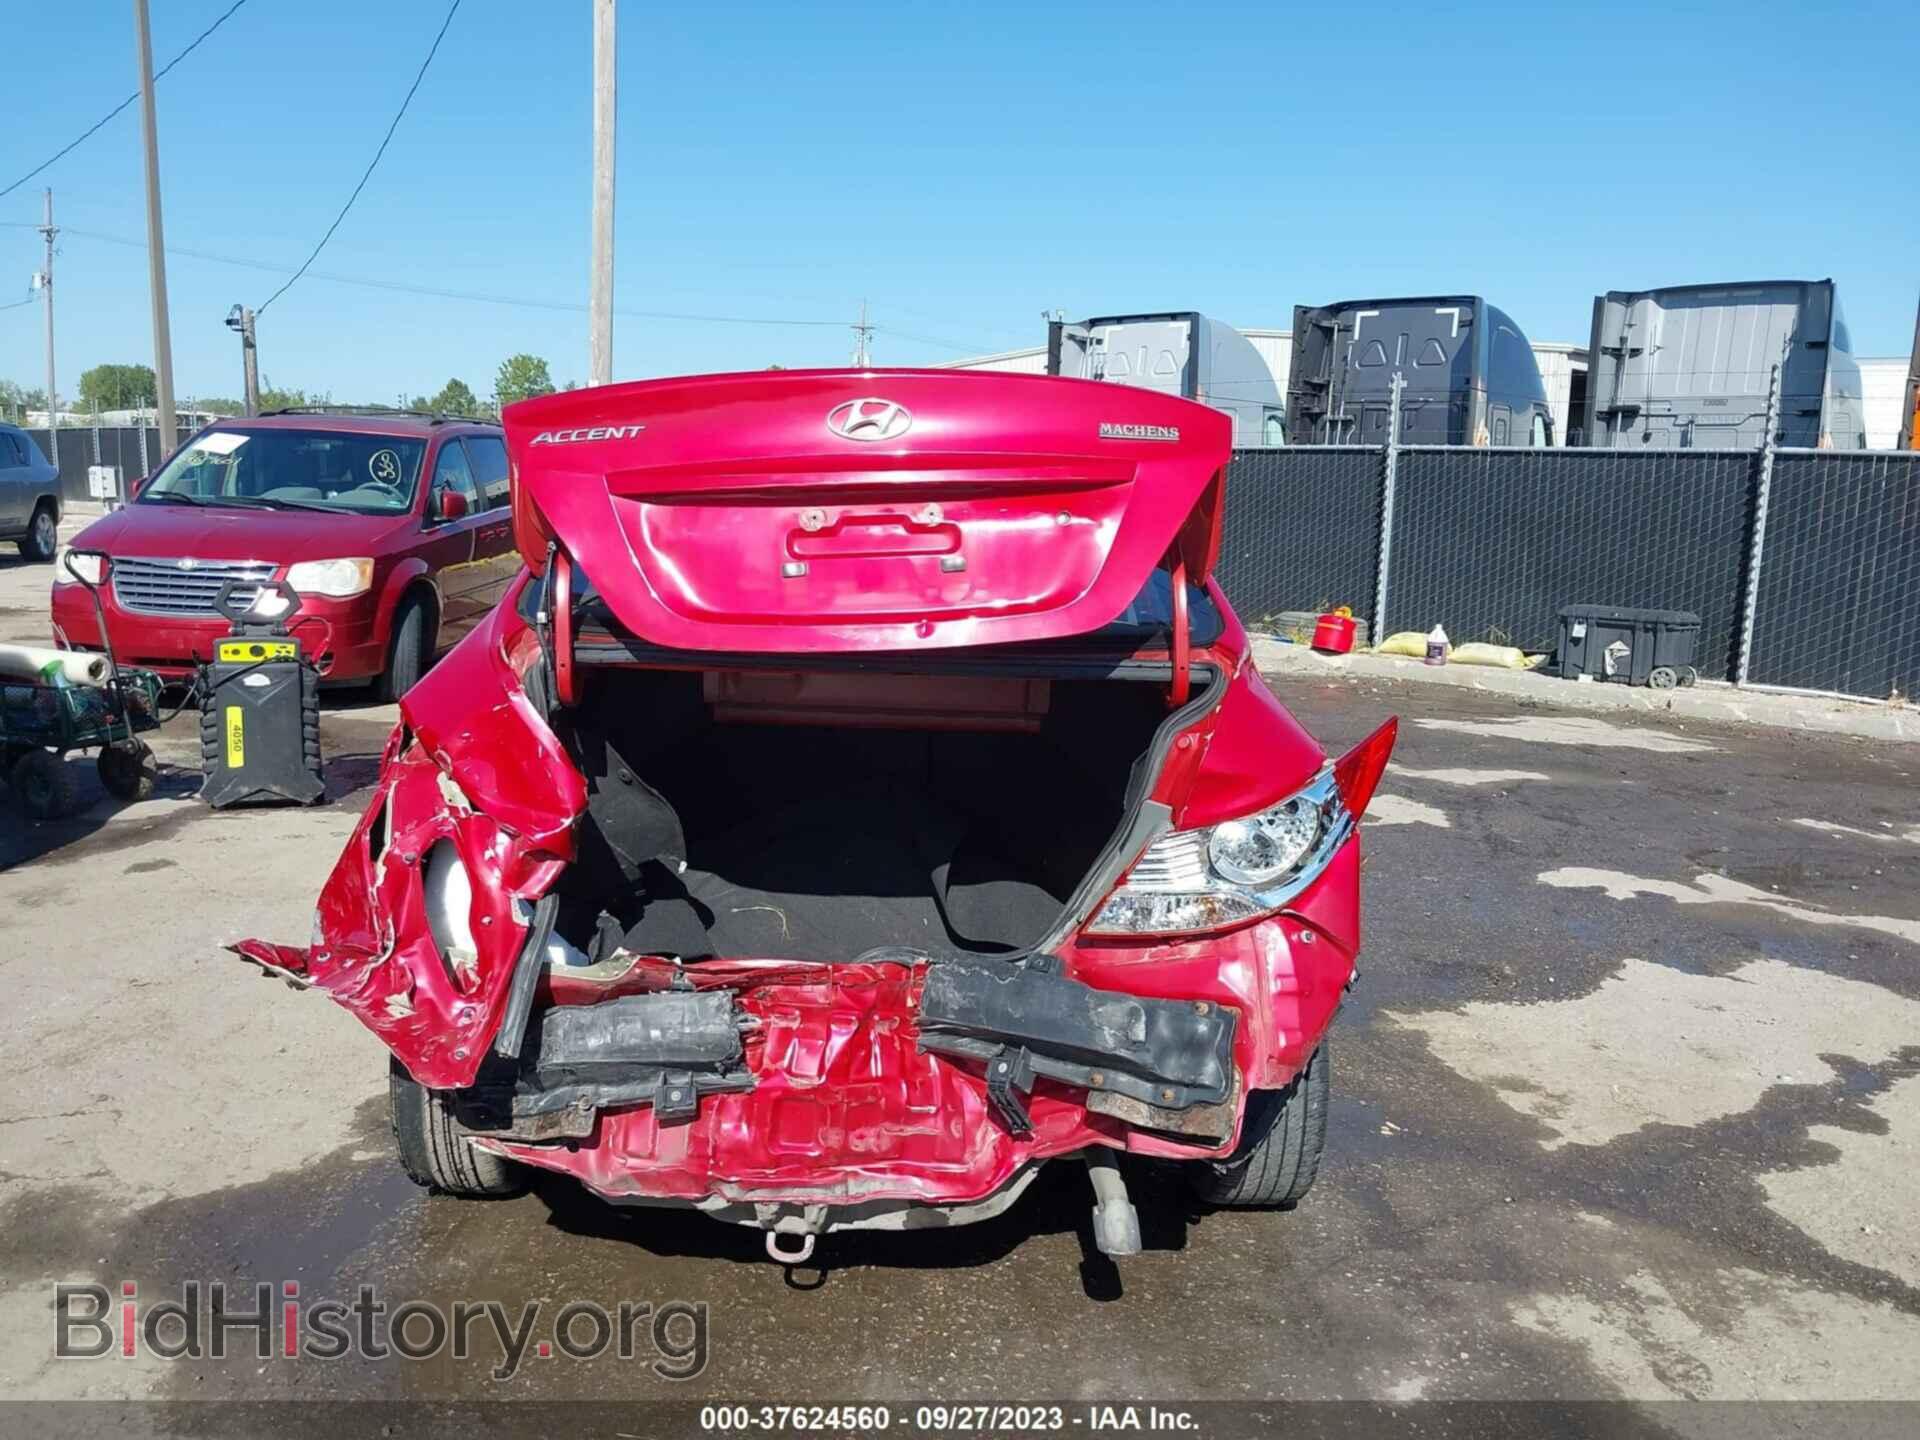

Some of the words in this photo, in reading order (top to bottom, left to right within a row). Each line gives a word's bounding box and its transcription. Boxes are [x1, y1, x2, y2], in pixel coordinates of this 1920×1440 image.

[529, 425, 646, 446] ACCENT
[1099, 422, 1180, 438] MACHENS
[232, 725, 243, 752] 4050
